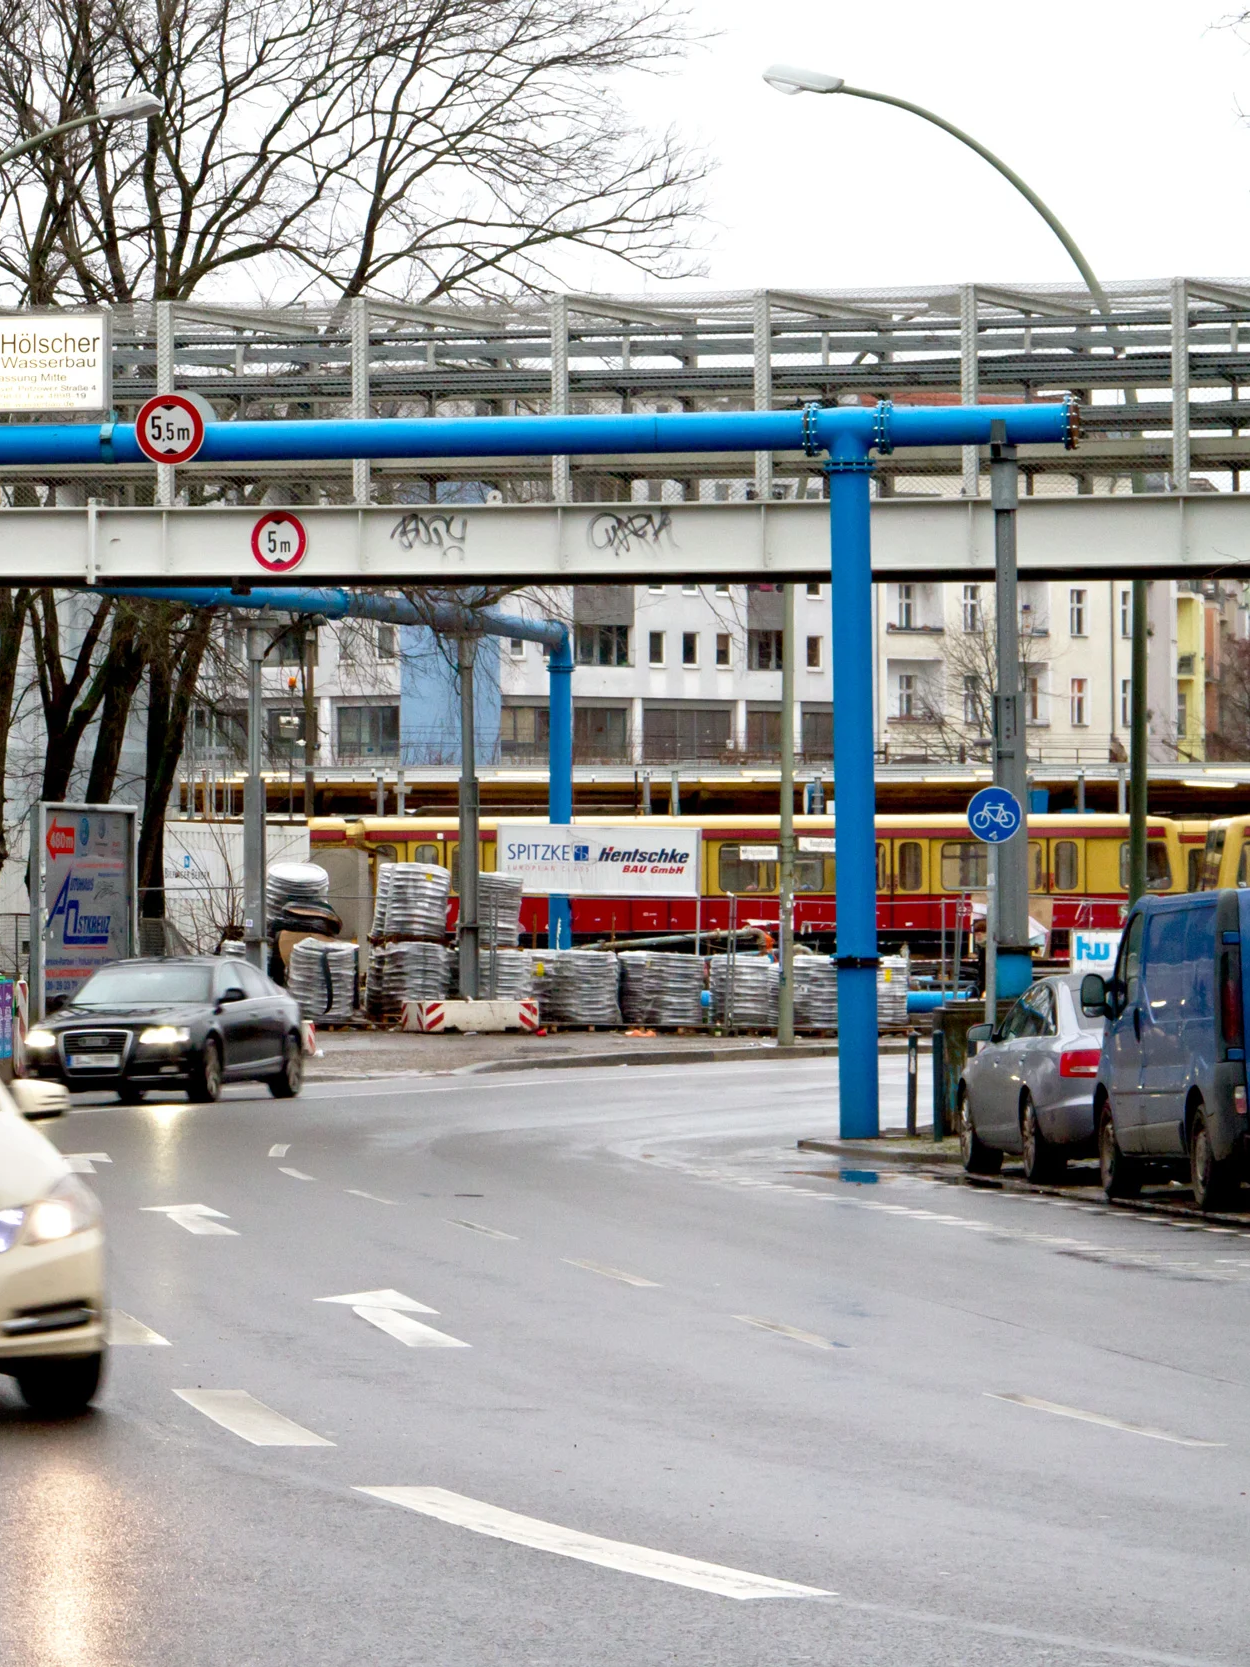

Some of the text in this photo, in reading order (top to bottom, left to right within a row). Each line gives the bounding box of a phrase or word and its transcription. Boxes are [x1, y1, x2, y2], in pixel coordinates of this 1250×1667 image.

[1, 333, 101, 354] Hölscher
[1, 357, 97, 370] Wasserbau
[40, 373, 68, 382] Mitte
[60, 384, 88, 393] Straße
[90, 384, 97, 392] 4
[151, 416, 175, 442] 5,5
[268, 530, 291, 553] 5 m
[507, 844, 690, 863] SPITZKE Hentschke
[622, 865, 685, 874] BAU GmbH
[1076, 936, 1110, 960] hw
